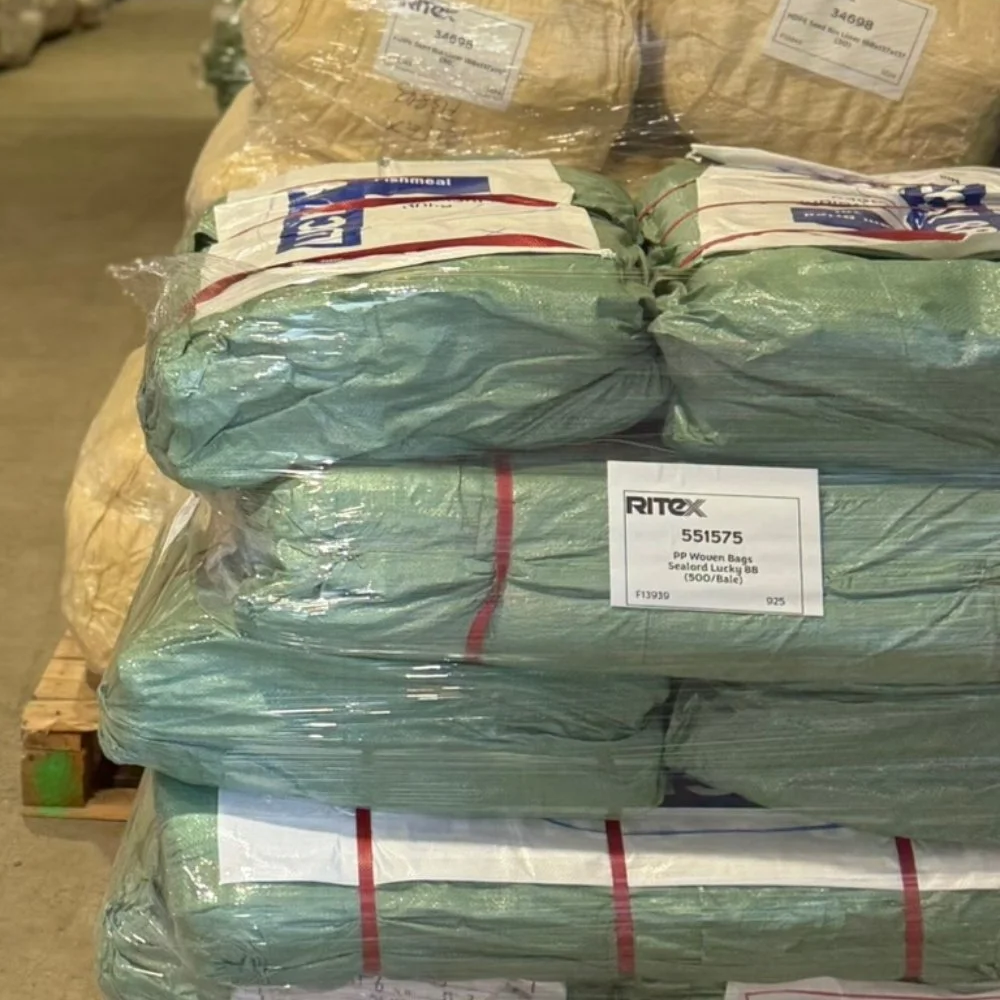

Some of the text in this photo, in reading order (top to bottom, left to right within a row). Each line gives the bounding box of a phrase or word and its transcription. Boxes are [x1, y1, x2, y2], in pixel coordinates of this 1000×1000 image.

[830, 7, 874, 31] 34698
[681, 529, 743, 544] 551575
[673, 551, 687, 560] PP
[728, 555, 753, 565] Bags
[668, 561, 708, 573] Sealord
[710, 563, 742, 576] Lucky
[684, 572, 743, 586] (500/Bale)
[636, 590, 786, 606] F13939 925
